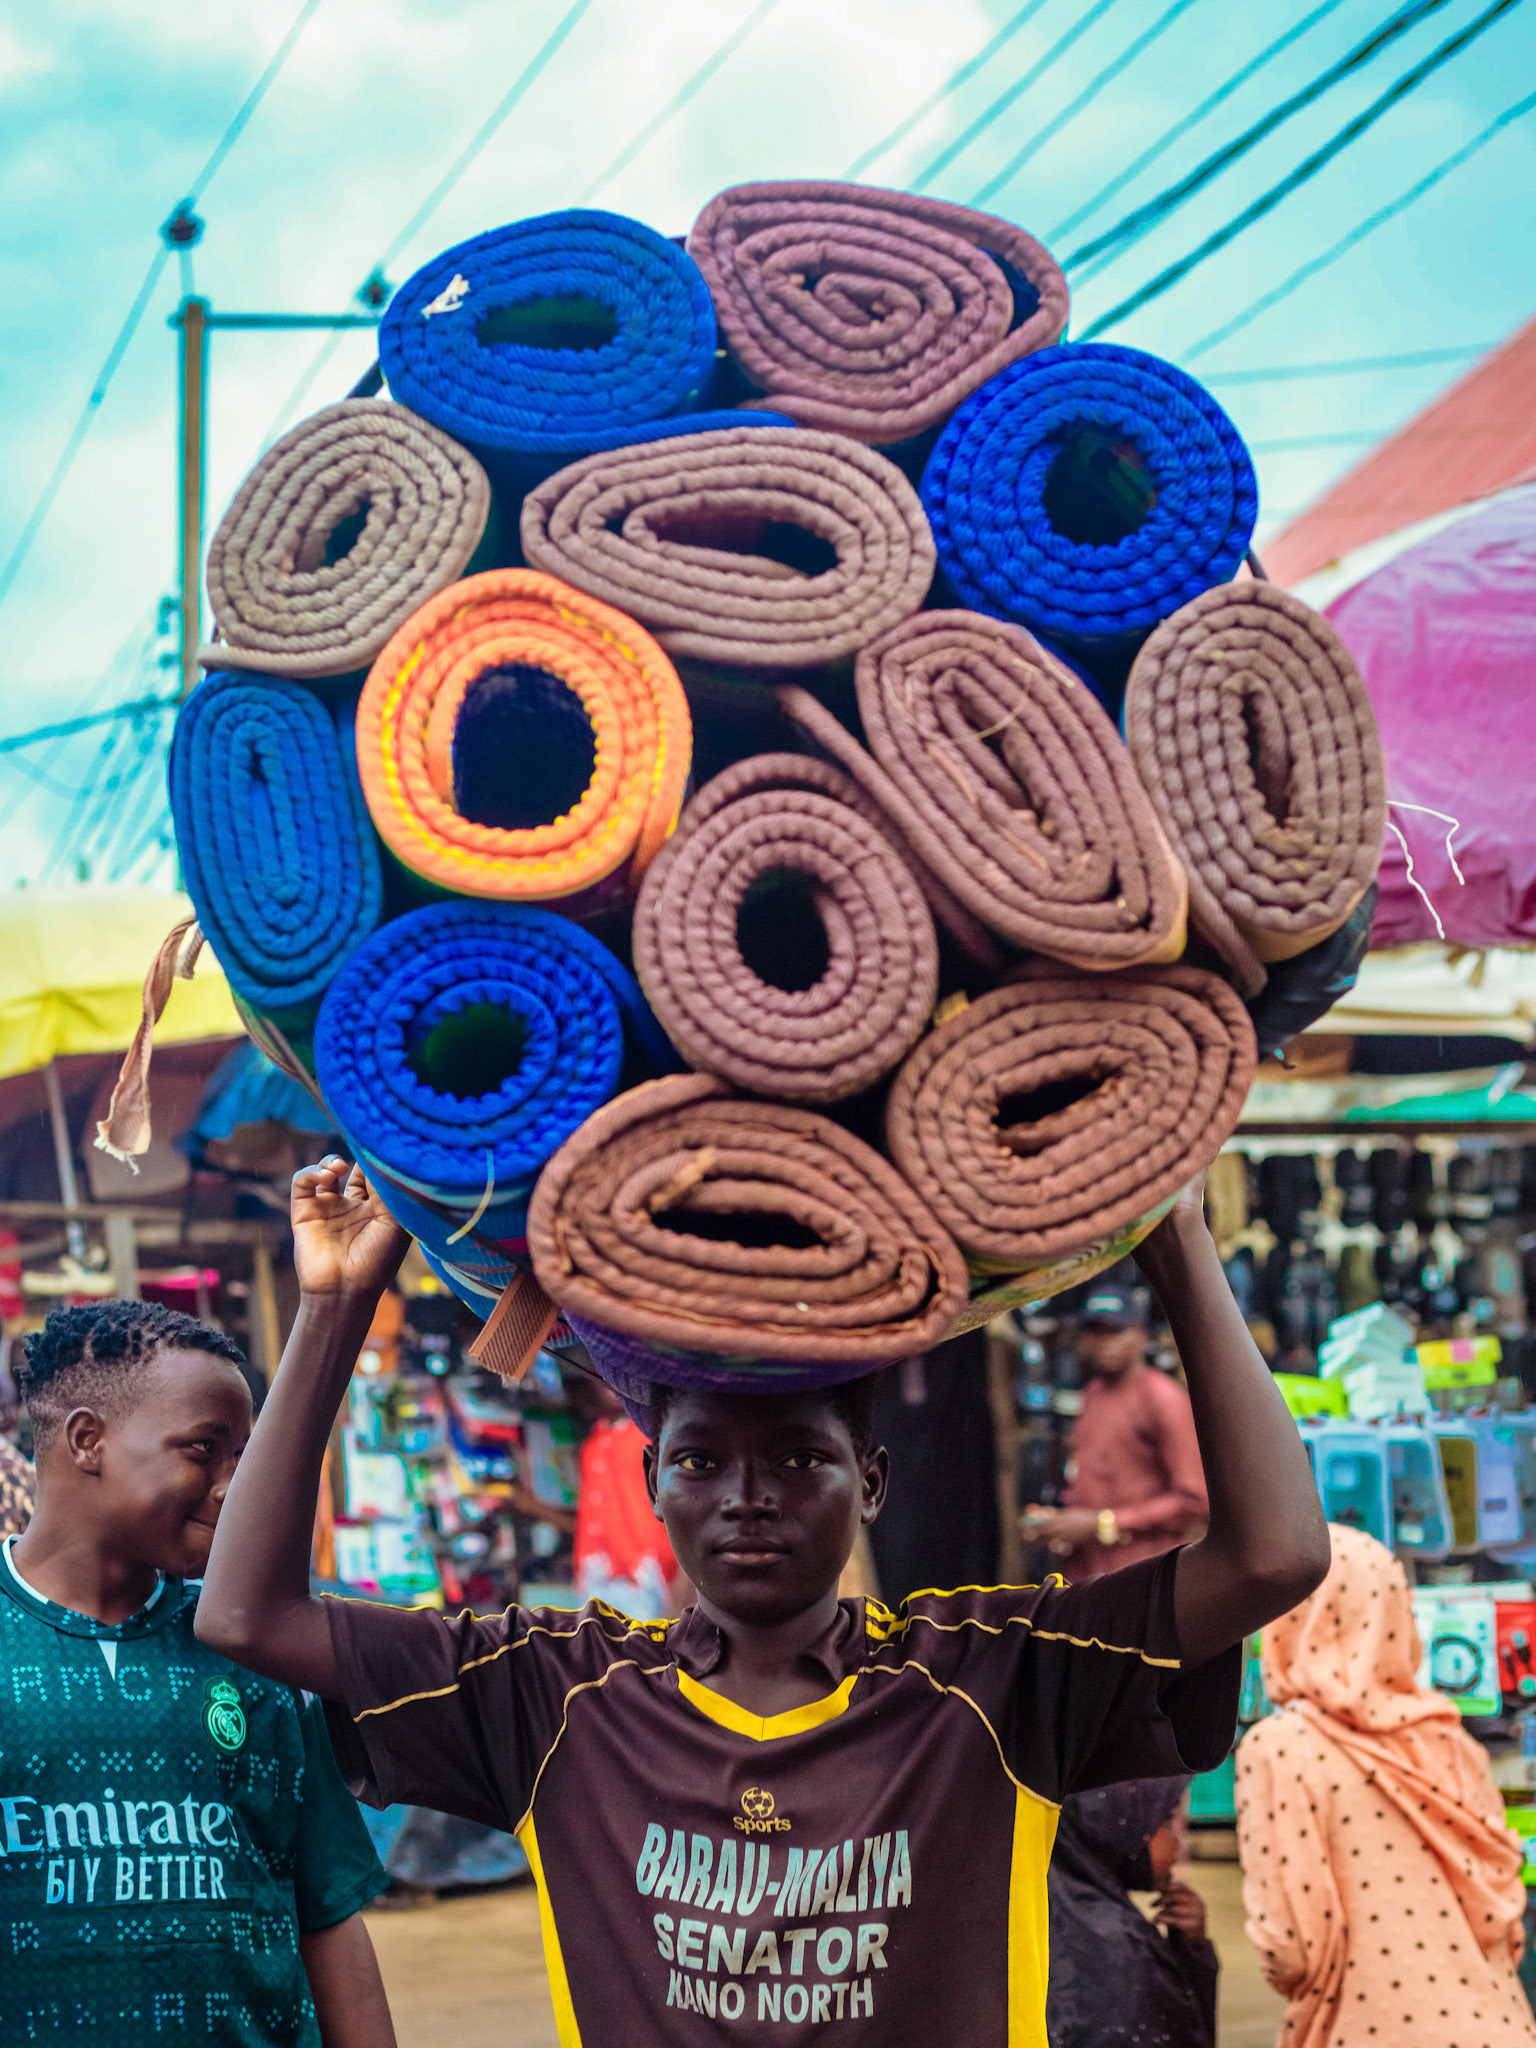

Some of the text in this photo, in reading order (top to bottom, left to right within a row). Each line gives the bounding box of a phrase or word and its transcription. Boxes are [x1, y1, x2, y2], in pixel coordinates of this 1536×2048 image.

[733, 1815, 792, 1835] Sports
[115, 1855, 227, 1901] BETTER
[636, 1822, 912, 1917] BARAU-MALIYA
[653, 1912, 889, 1976] SENATOR
[666, 1968, 874, 2024] KANO NORTH
